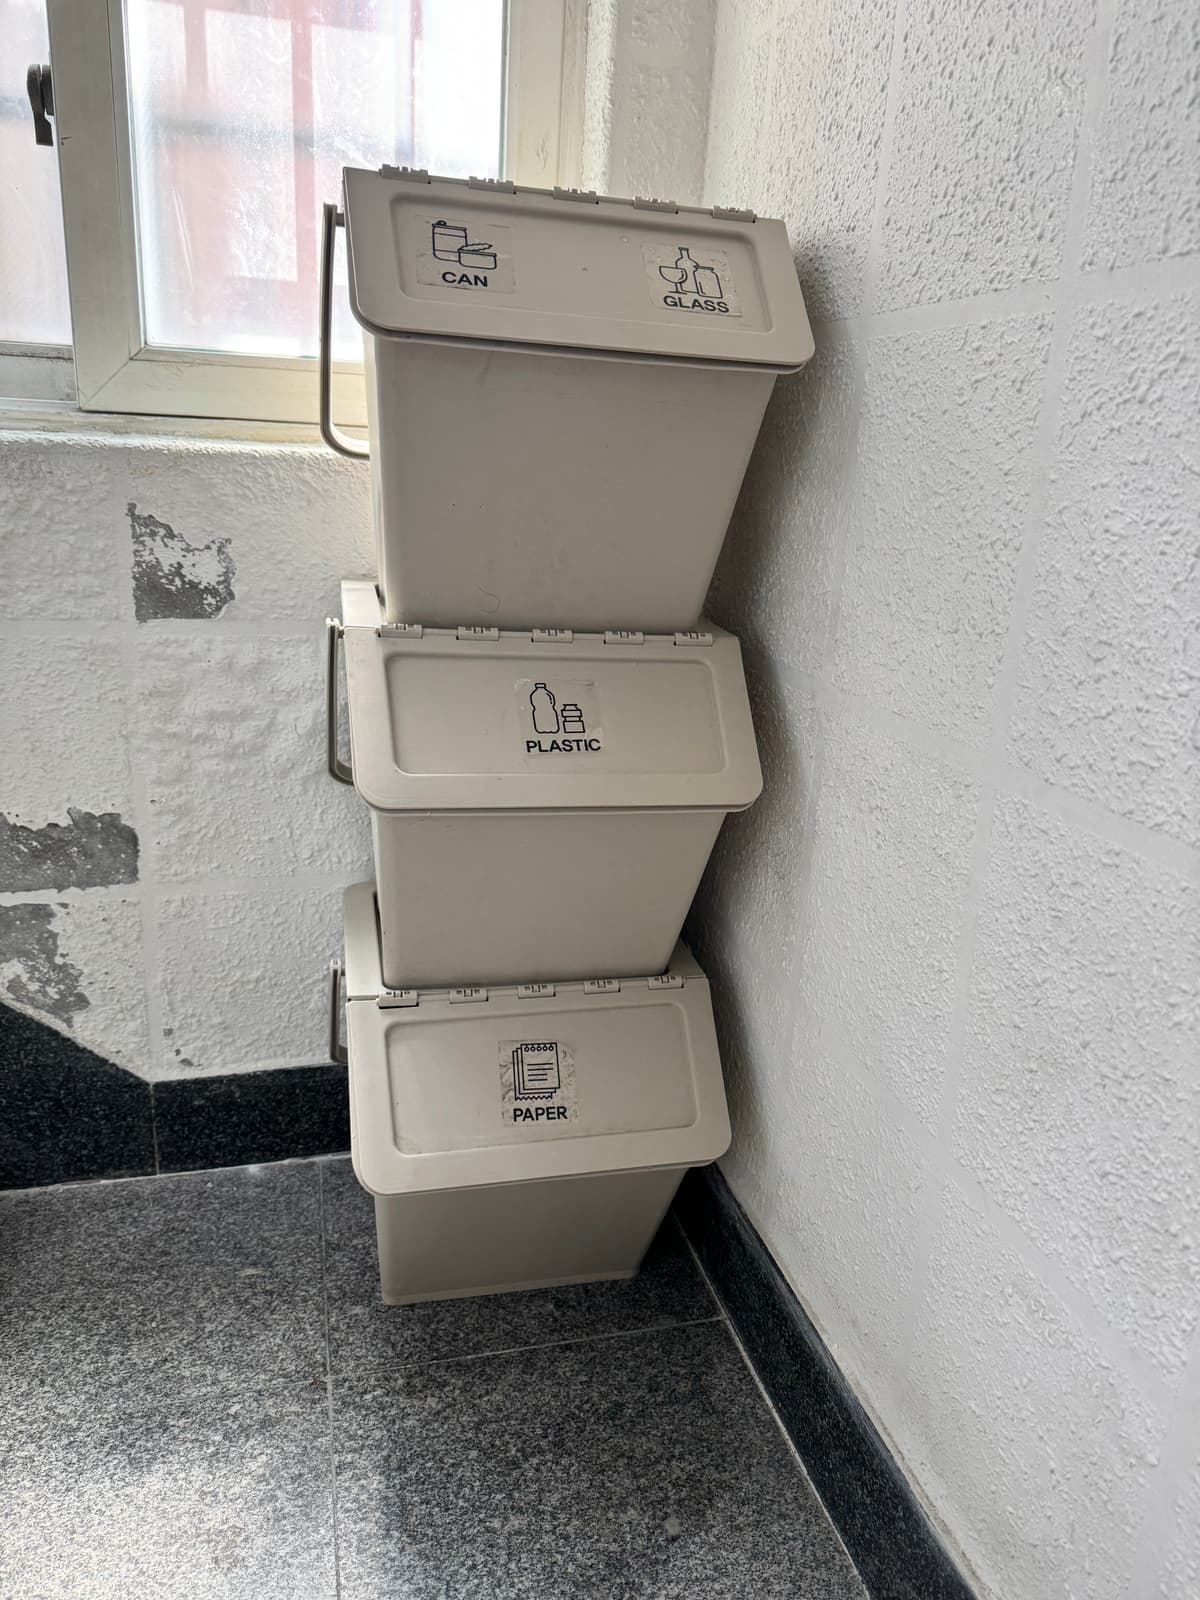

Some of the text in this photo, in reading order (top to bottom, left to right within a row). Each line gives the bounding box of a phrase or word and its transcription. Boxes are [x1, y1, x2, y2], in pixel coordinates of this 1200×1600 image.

[441, 271, 489, 288] CAN
[663, 295, 730, 314] GLASS
[525, 738, 602, 754] PLASTIC
[512, 1105, 569, 1123] PAPER
